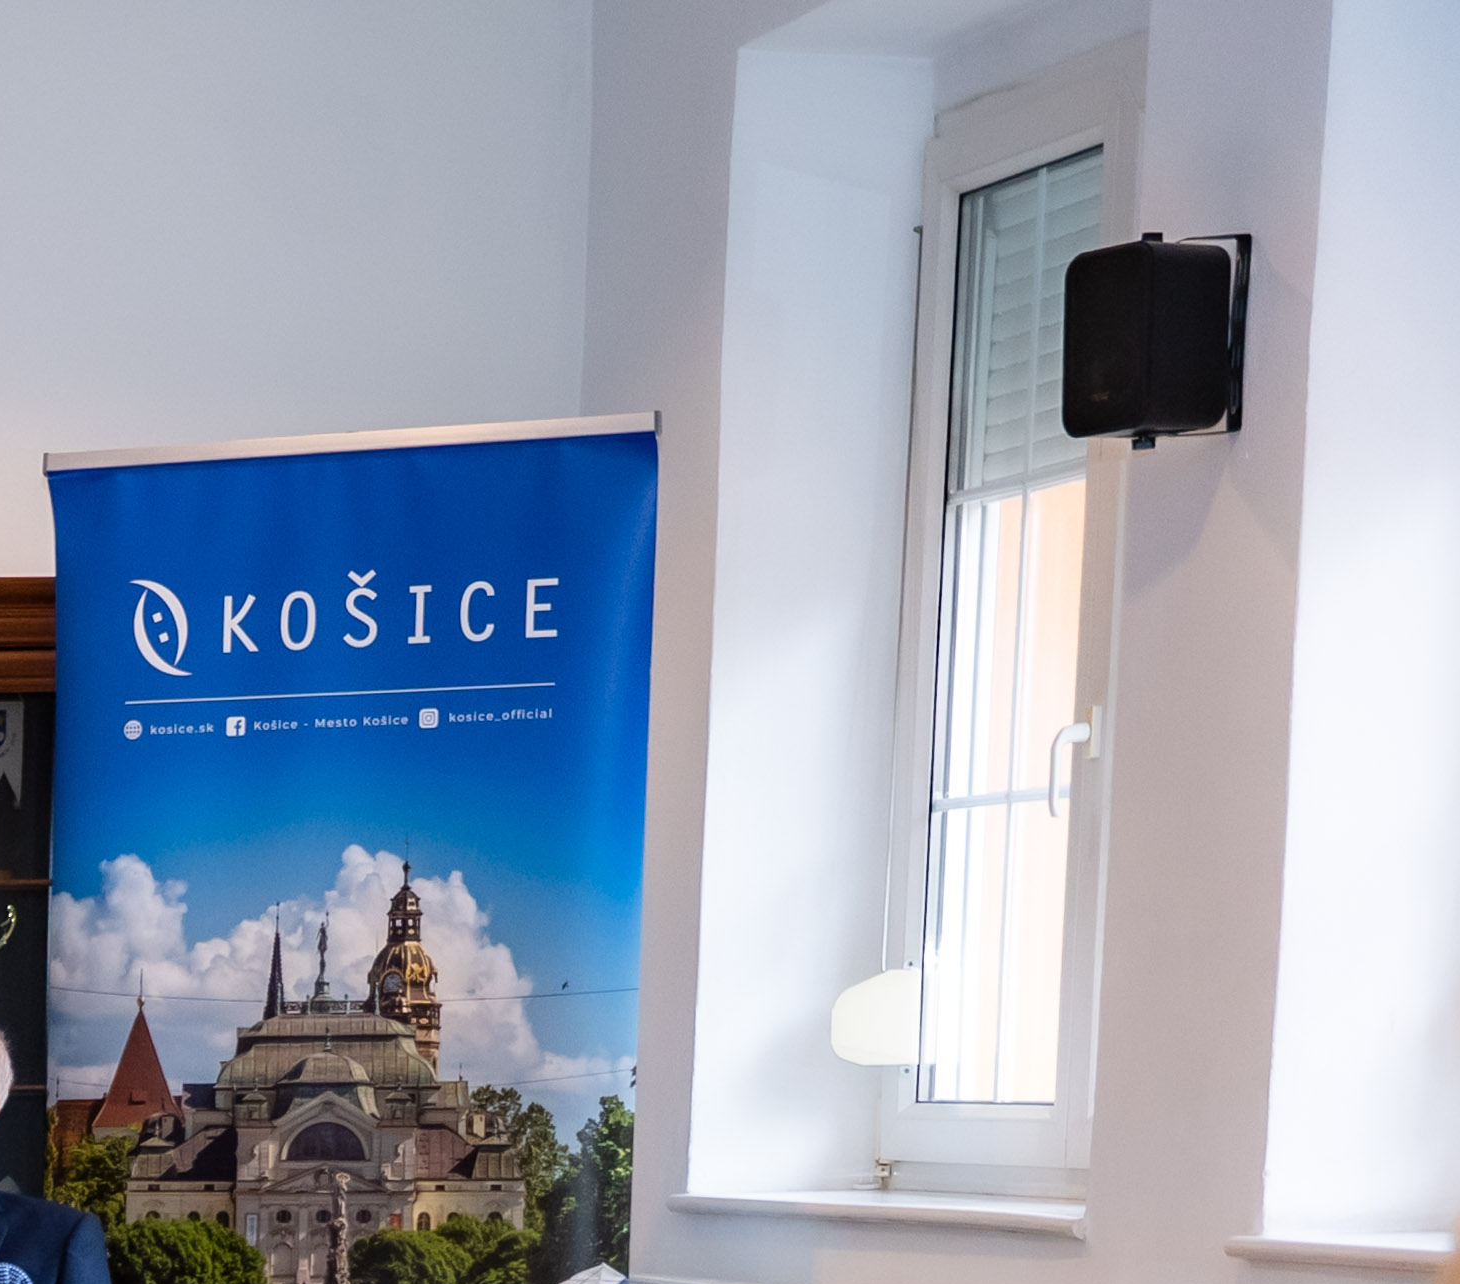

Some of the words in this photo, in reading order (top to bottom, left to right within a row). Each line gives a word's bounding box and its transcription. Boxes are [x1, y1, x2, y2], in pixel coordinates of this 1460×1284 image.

[222, 569, 559, 653] KOŠICE
[253, 718, 298, 731] Košice
[315, 717, 357, 729] Mesto
[362, 714, 409, 727] Košice
[448, 707, 553, 723] kosice_official
[150, 722, 214, 736] kosice.sk
